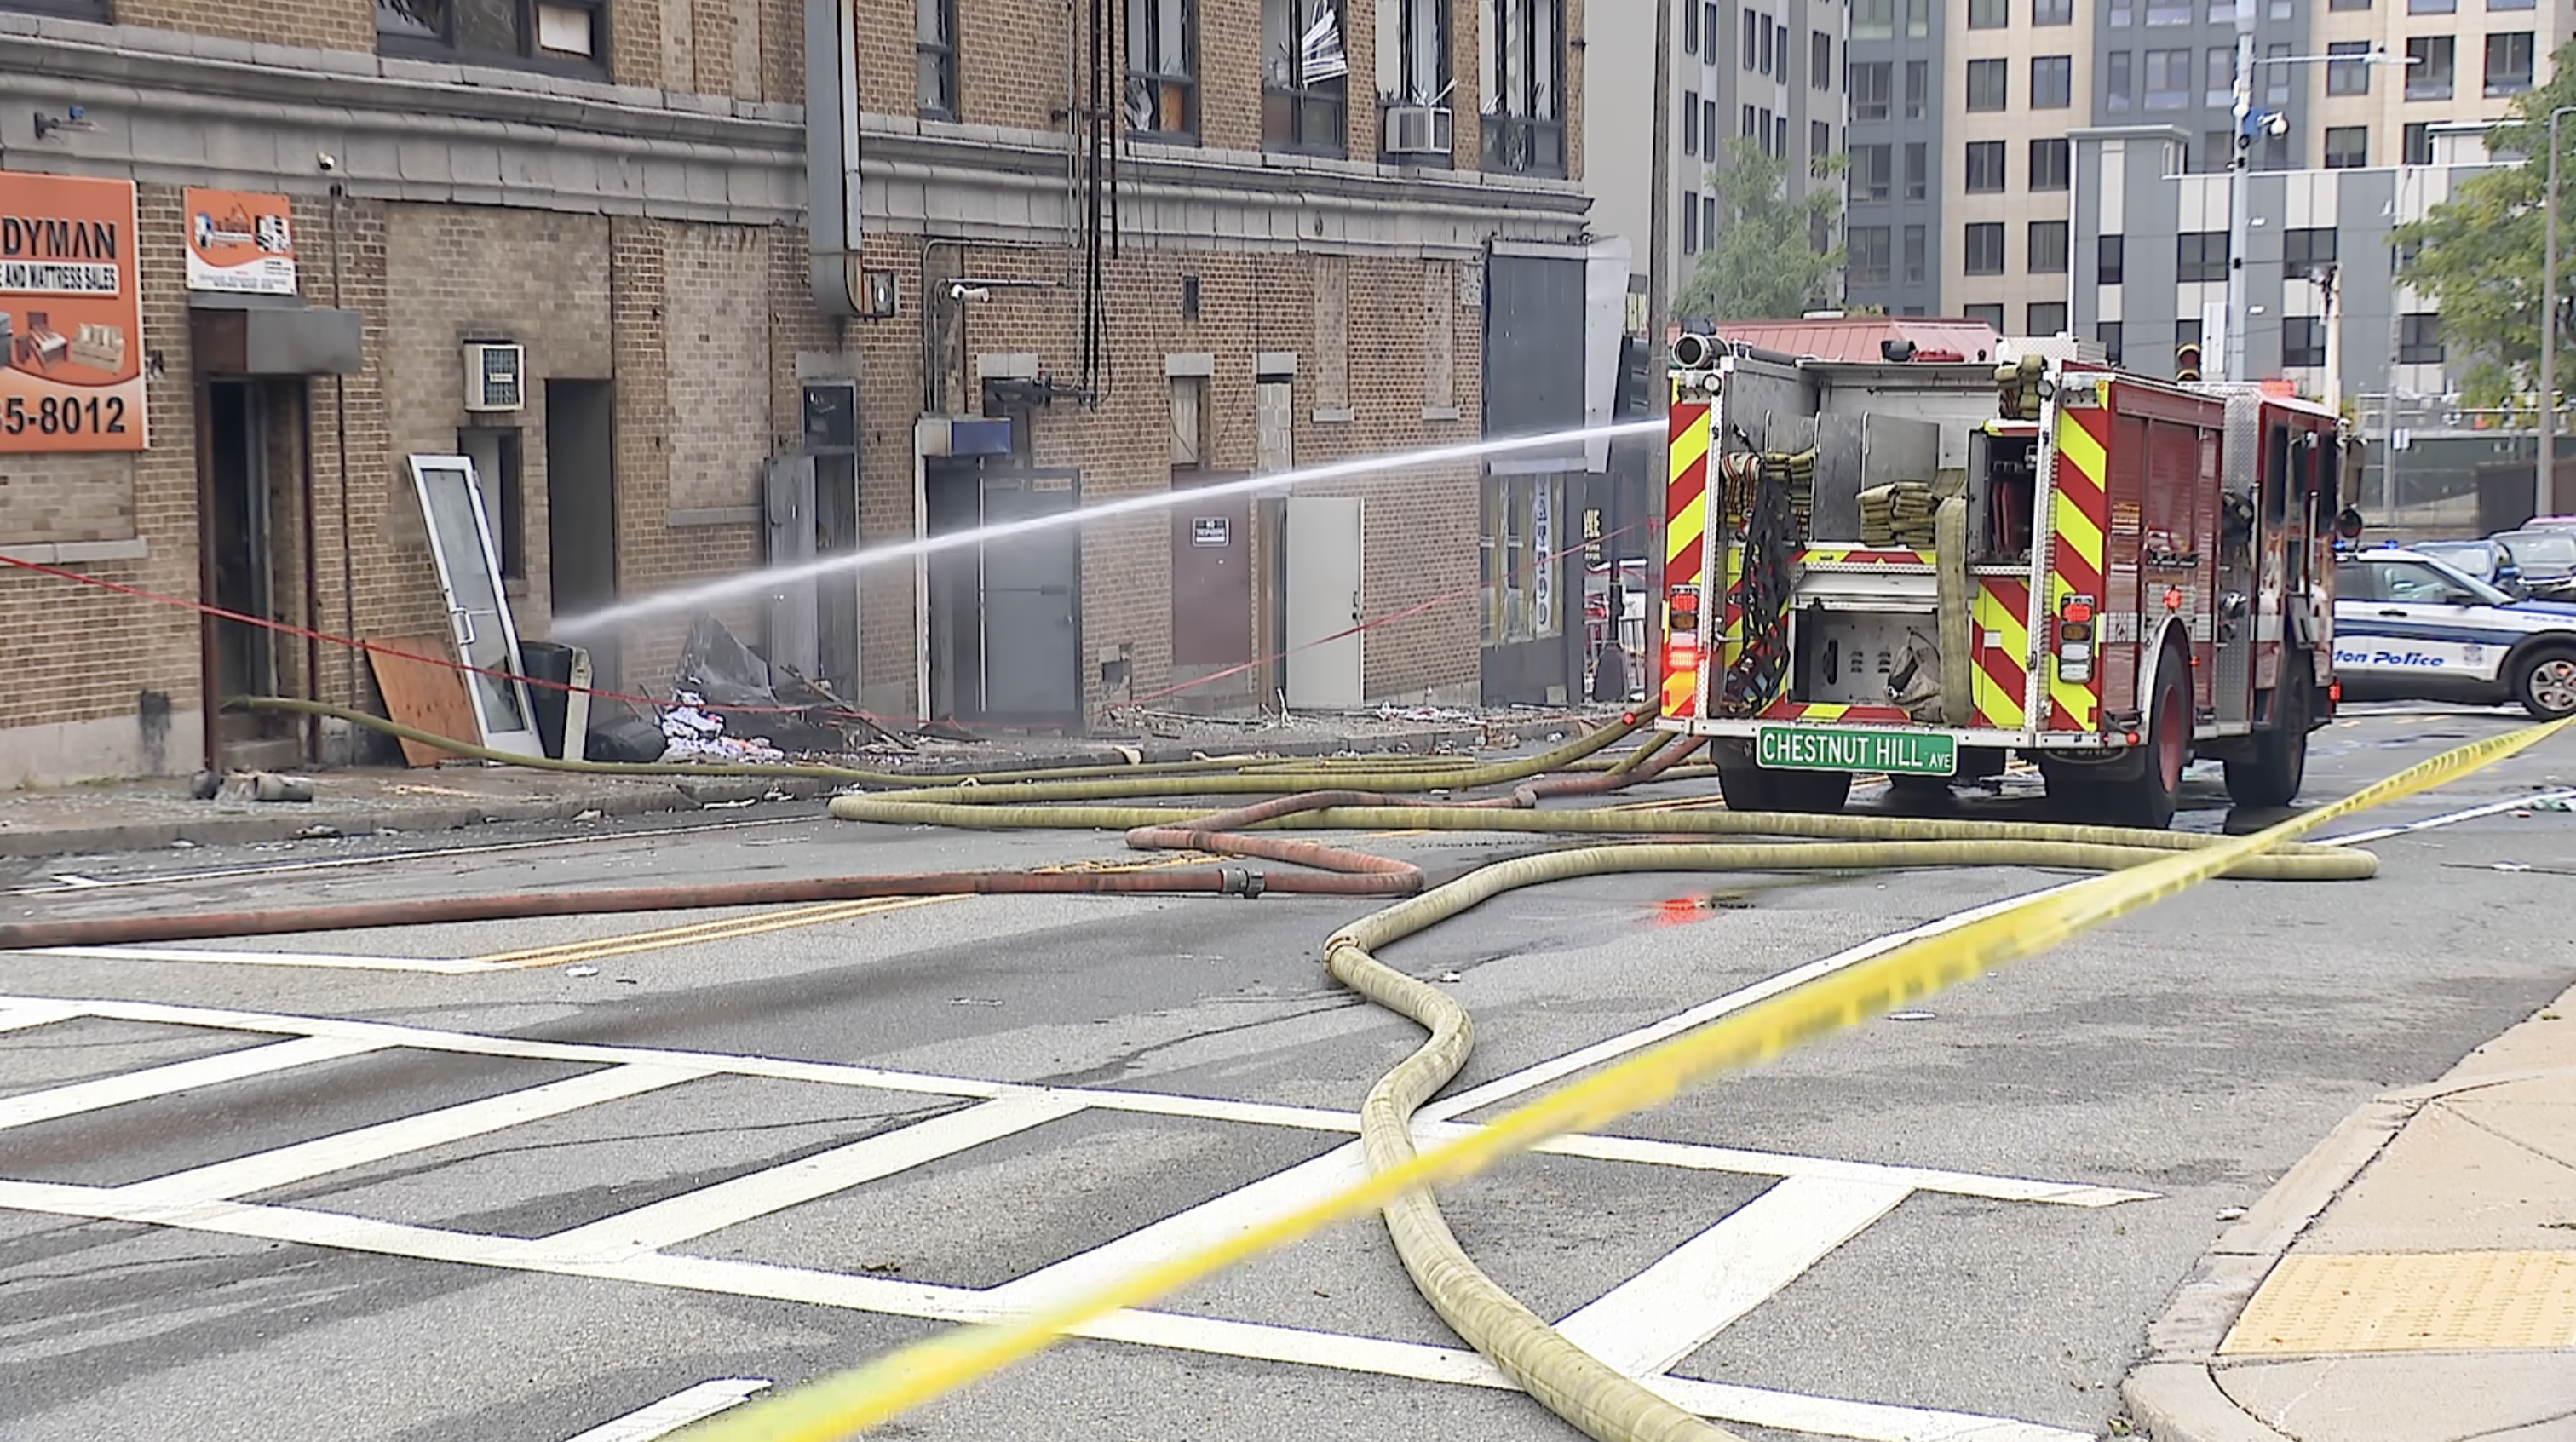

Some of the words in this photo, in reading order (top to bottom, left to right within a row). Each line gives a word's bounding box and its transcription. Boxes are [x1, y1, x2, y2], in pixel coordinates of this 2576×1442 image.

[3, 217, 116, 259] DYMAN
[4, 264, 26, 288] AND
[29, 264, 83, 290] MATTRESS
[85, 266, 116, 290] SALES
[0, 396, 125, 435] 5-8012
[2373, 651, 2445, 667] Police
[1762, 732, 1869, 765] CHESTNUT
[1876, 738, 1923, 767] HILL
[1929, 753, 1952, 768] AVE
